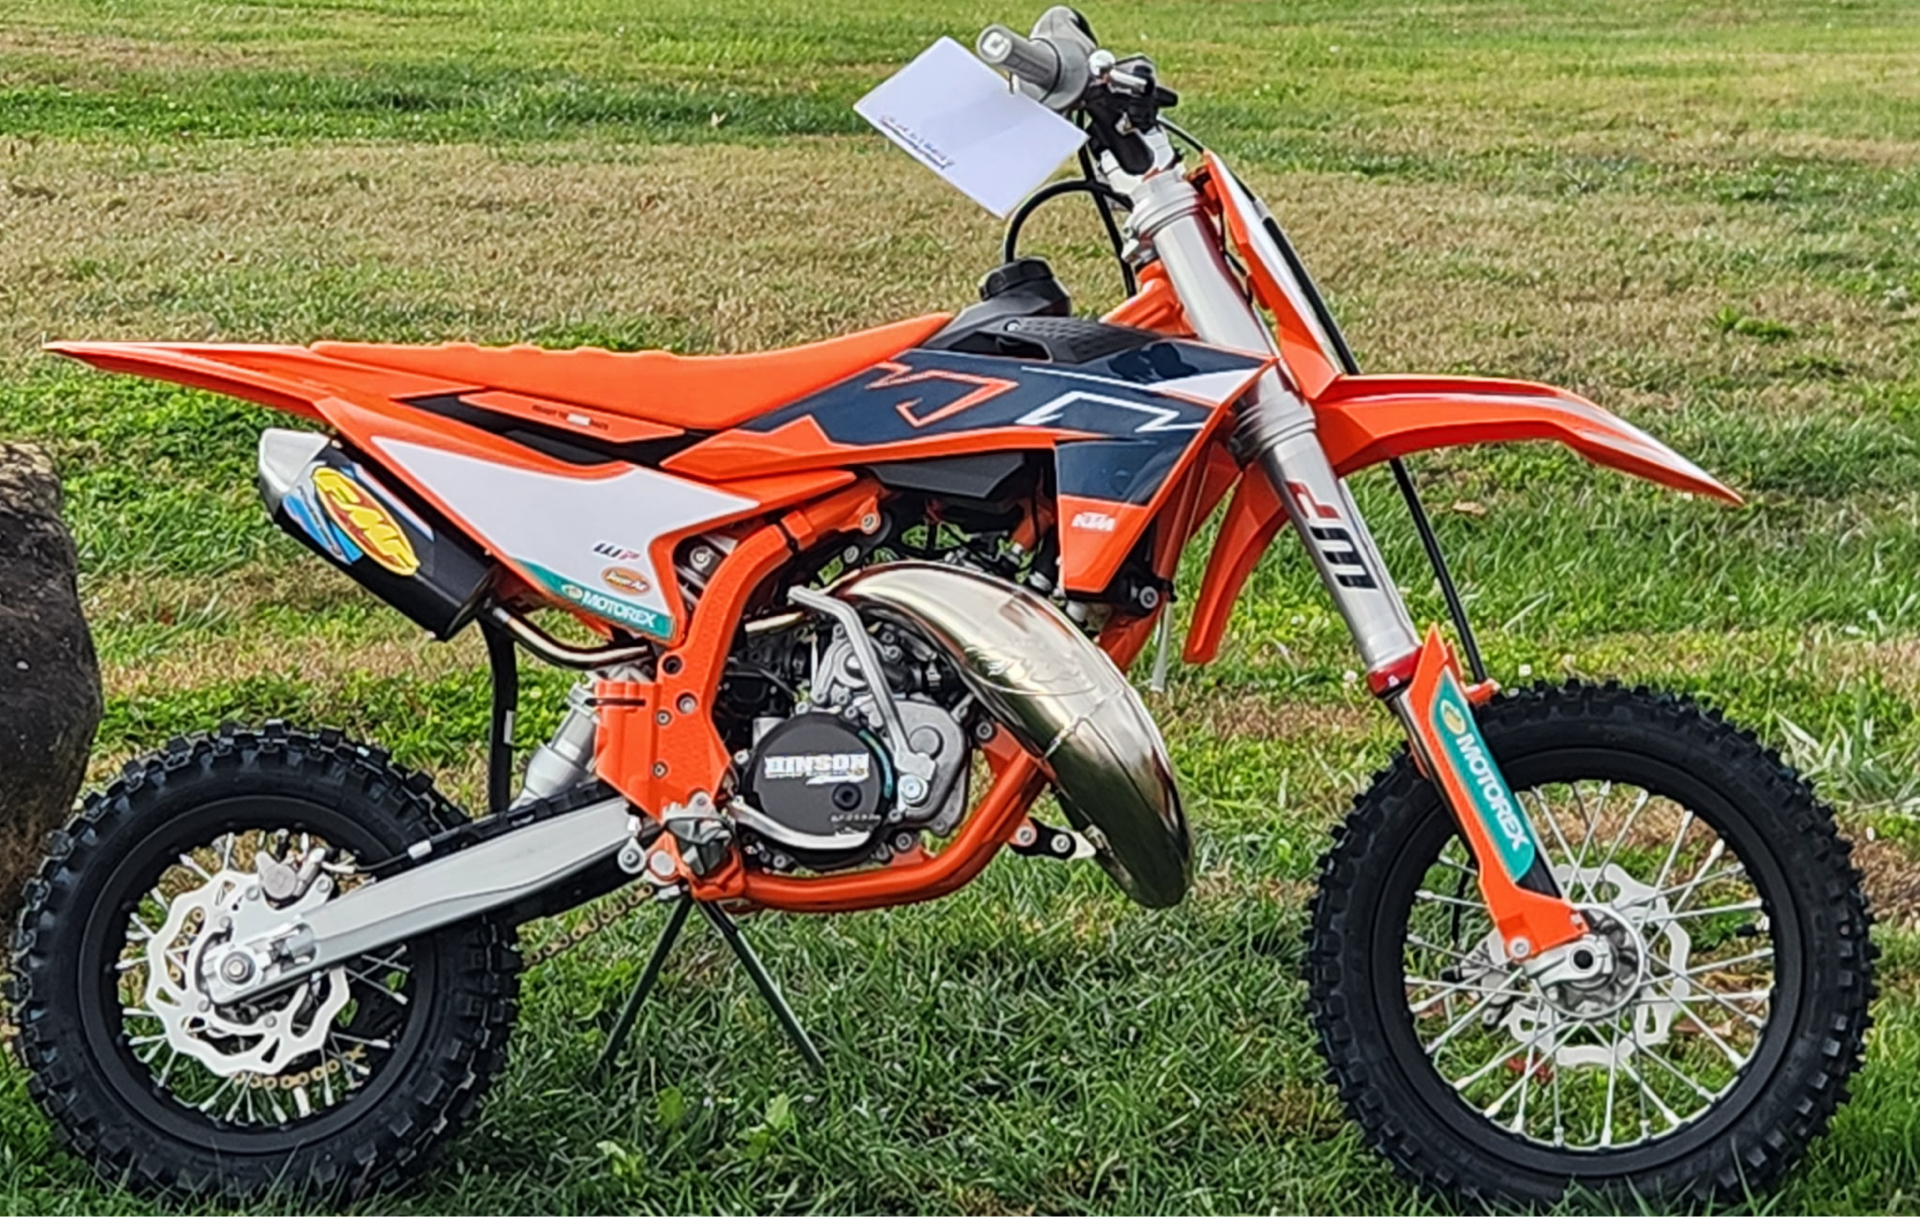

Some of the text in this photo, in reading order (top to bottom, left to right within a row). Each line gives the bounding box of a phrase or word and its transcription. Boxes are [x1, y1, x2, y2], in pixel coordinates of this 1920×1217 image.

[313, 468, 420, 569] FMF
[1071, 511, 1115, 532] KTM
[581, 588, 658, 629] MOTOREX
[1456, 733, 1531, 851] MOTOREX
